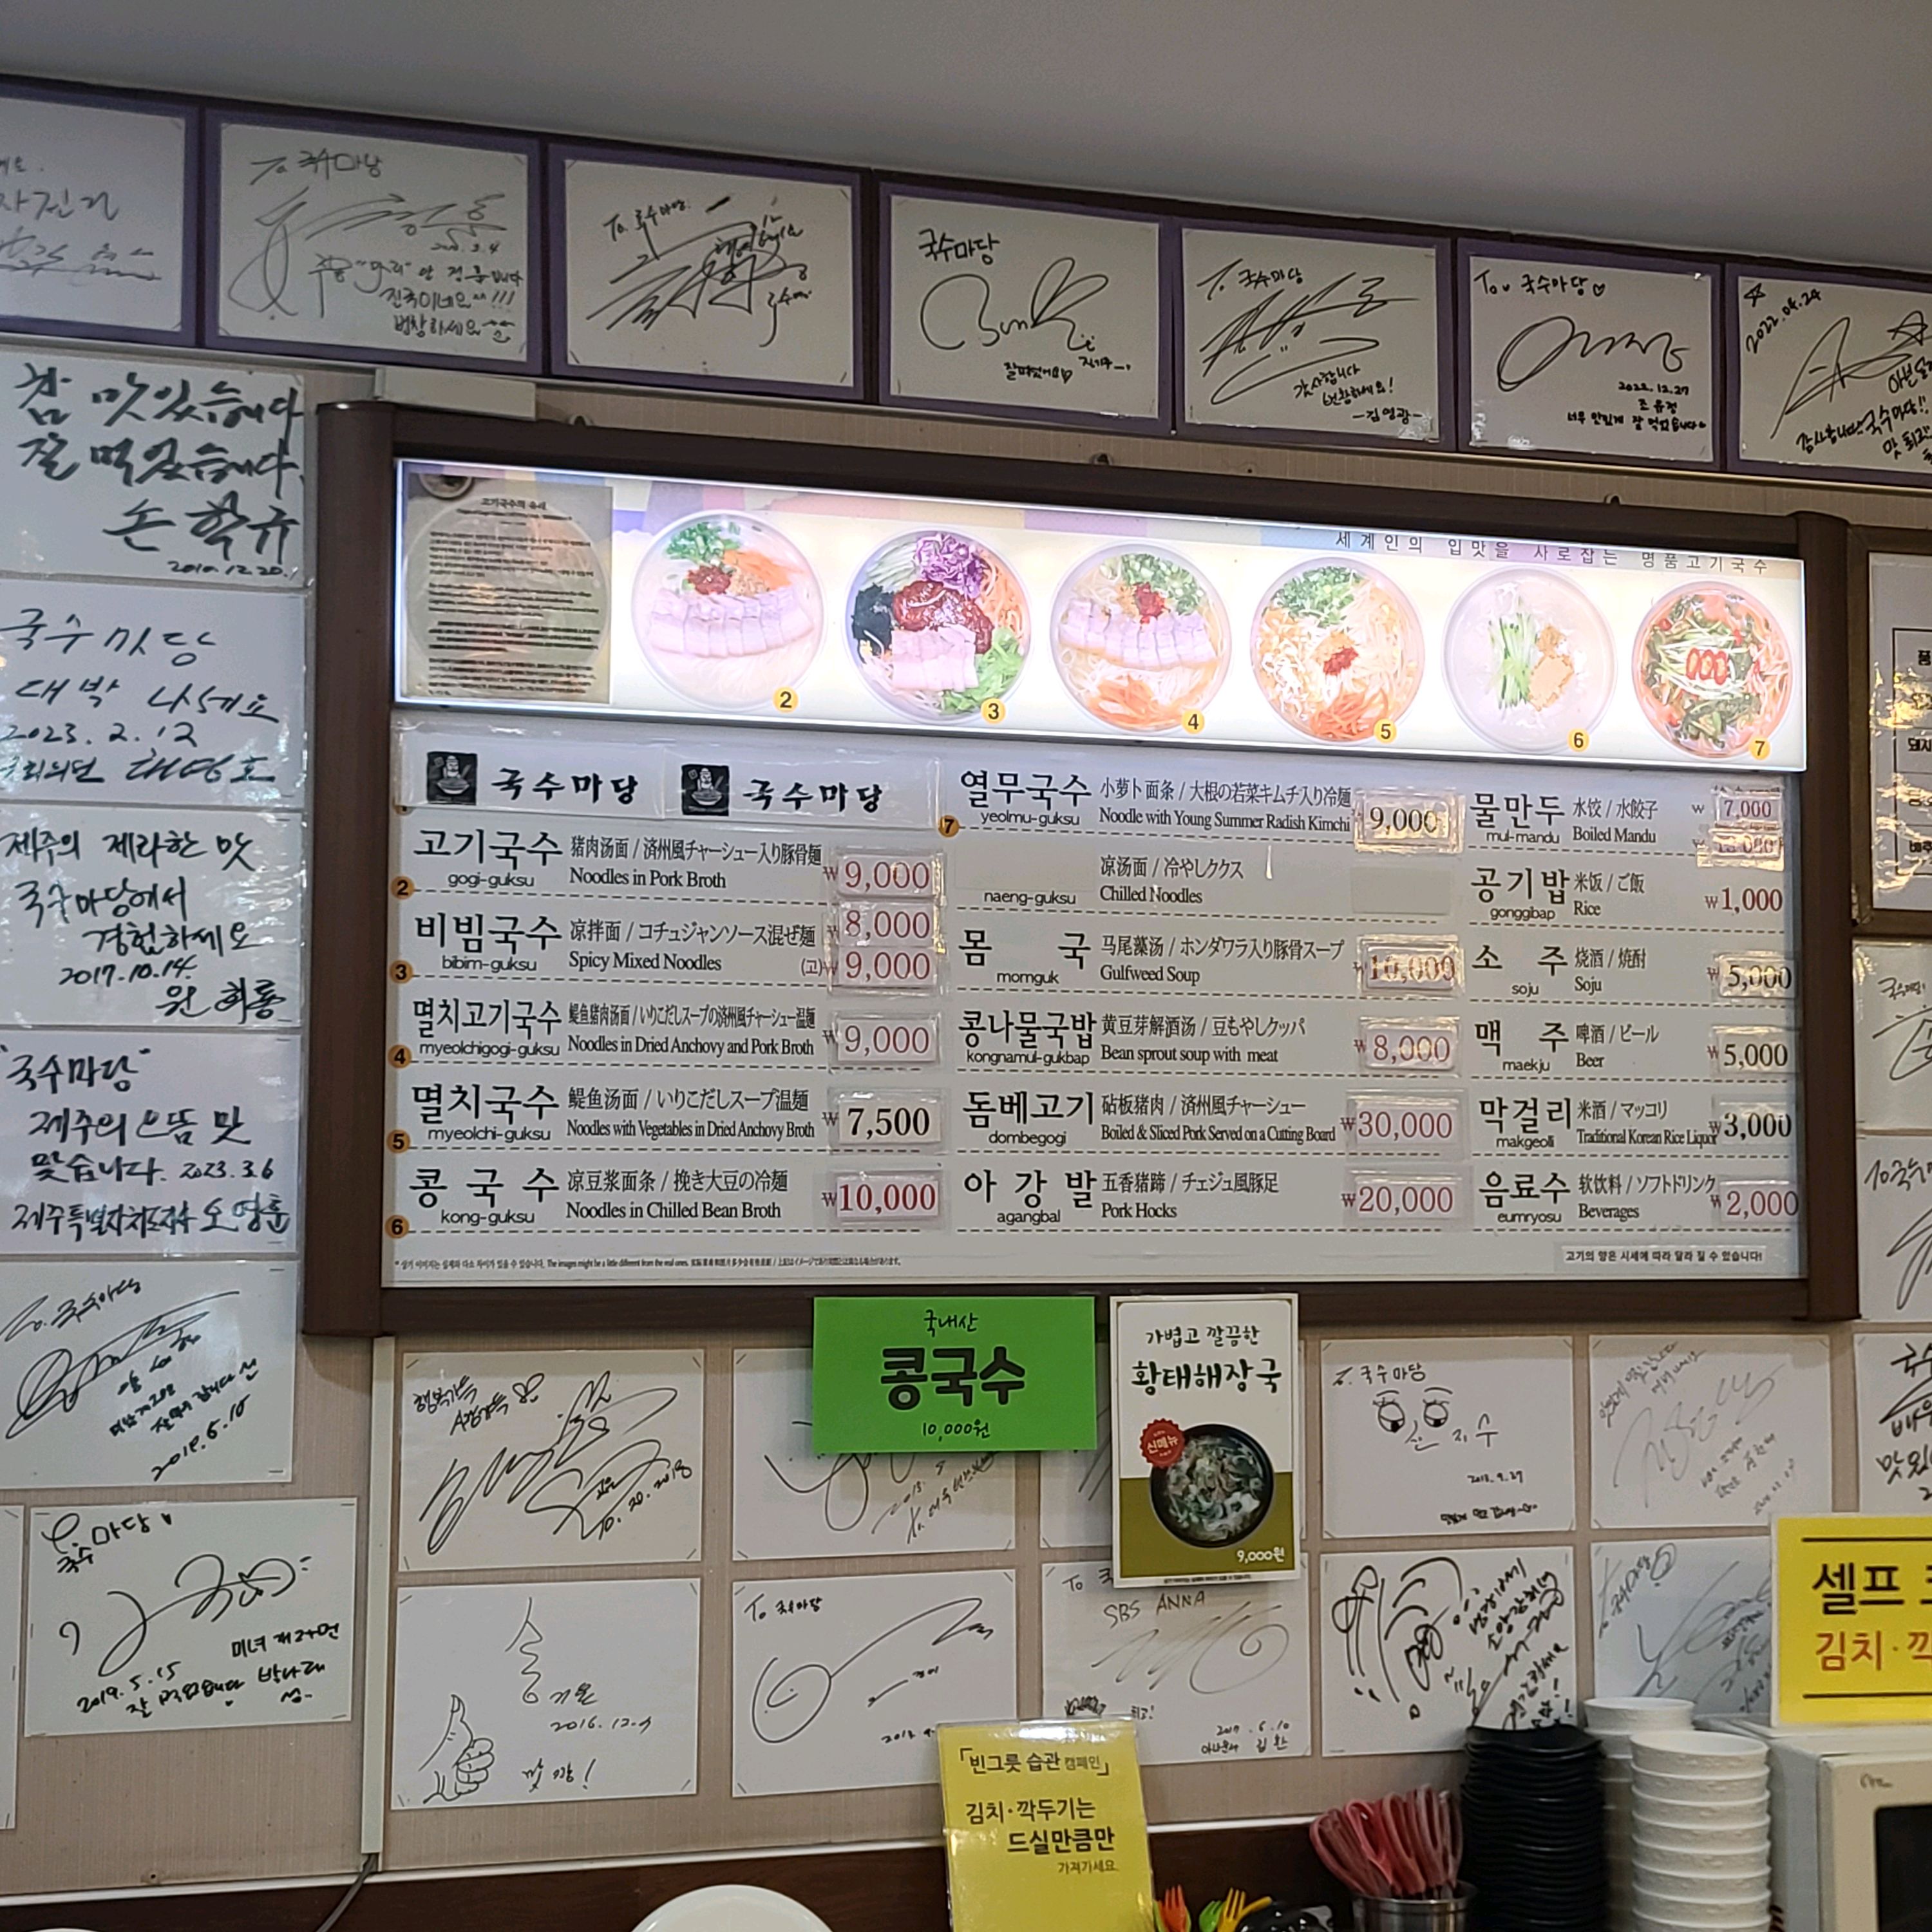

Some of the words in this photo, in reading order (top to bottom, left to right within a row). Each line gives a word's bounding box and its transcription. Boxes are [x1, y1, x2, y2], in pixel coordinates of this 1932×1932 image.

[1336, 531, 1423, 554] 세계인의
[1448, 538, 1510, 559] 입맛을
[1534, 545, 1618, 567] 사로잡는
[1641, 552, 1768, 574] 명품고기국수
[491, 767, 638, 805] 국수마당
[743, 779, 883, 813] 국수마당
[960, 770, 1092, 811] 열무국수
[980, 809, 1080, 828] yeolmu-guksu
[1098, 806, 1144, 824] Noodle
[1145, 809, 1172, 826] with
[1173, 810, 1212, 831] Young
[1214, 811, 1265, 829] Summer
[1265, 813, 1306, 831] Radish
[1307, 815, 1350, 832] Kimchi
[1469, 793, 1566, 829] 물만두
[1572, 797, 1602, 819] 水饺
[1486, 828, 1560, 844] mul-mandu
[1572, 826, 1612, 842] Boiled
[1614, 827, 1656, 844] Mandu
[413, 828, 564, 869] 고기국수
[570, 835, 629, 859] 猪肉汤面
[448, 871, 535, 889] gogi-guksu
[569, 866, 630, 885] Noodles
[632, 868, 647, 886] in
[649, 869, 684, 887] Pork
[686, 870, 726, 889] Broth
[1470, 867, 1571, 905] 공기밥
[1573, 871, 1604, 893] 米饭
[1617, 872, 1645, 894] ご飯
[983, 890, 1076, 907] naeng-guksu
[1099, 885, 1147, 902] Chilled
[1149, 886, 1203, 904] Noodles
[1490, 905, 1556, 922] gonggibap
[1573, 900, 1601, 916] Rice
[415, 912, 563, 955] 비빔국수
[442, 954, 537, 974] bibim-guksu
[569, 950, 611, 972] Spicy
[612, 951, 660, 969] Mixed
[663, 952, 722, 971] Noodles
[996, 970, 1059, 987] momguk
[1100, 964, 1164, 981] Gulfweed
[1166, 965, 1200, 987] Soup
[1574, 976, 1602, 996] Soju
[1511, 982, 1539, 998] soju
[413, 997, 562, 1041] 멸치고기국수
[958, 1009, 1097, 1050] 콩나물국밥
[1576, 1022, 1605, 1045] 啤酒
[1620, 1023, 1660, 1044] ビール
[419, 1039, 560, 1059] myeolchigogi-guksu
[567, 1034, 618, 1052] Noodles
[620, 1035, 632, 1053] in
[634, 1036, 669, 1053] Dried
[670, 1036, 725, 1059] Anchovy
[726, 1037, 749, 1054] and
[751, 1037, 779, 1055] Pork
[781, 1038, 815, 1056] Broth
[967, 1048, 1090, 1067] kongnamul-gukbap
[1100, 1043, 1135, 1061] Bean
[1137, 1047, 1178, 1065] sprout
[1179, 1049, 1211, 1066] soup
[1213, 1045, 1242, 1062] with
[1247, 1049, 1279, 1063] meat
[1502, 1058, 1551, 1074] maekju
[1575, 1052, 1605, 1068] Beer
[412, 1083, 560, 1126] 멸치국수
[962, 1090, 1094, 1128] 돔베고기
[1479, 1096, 1571, 1134] 막걸리
[1577, 1099, 1607, 1121] 米酒
[1620, 1100, 1667, 1121] マッコリ
[428, 1125, 551, 1144] myeolchi-guksu
[567, 1119, 611, 1137] Noodles
[612, 1119, 636, 1137] with
[638, 1119, 693, 1141] Vegetables
[694, 1119, 705, 1137] in
[706, 1120, 737, 1137] Dried
[737, 1121, 784, 1142] Anchovy
[786, 1121, 815, 1138] Broth
[988, 1130, 1067, 1148] dombegogi
[1576, 1128, 1627, 1144] Traditional
[1627, 1128, 1662, 1145] Korean
[1663, 1129, 1685, 1145] Rice
[1496, 1134, 1555, 1151] makgeolli
[1478, 1171, 1571, 1208] 음료수
[440, 1209, 535, 1227] kong-guksu
[565, 1201, 627, 1219] Noodles
[629, 1201, 644, 1218] in
[647, 1201, 699, 1219] Chilled
[701, 1201, 739, 1218] Bean
[741, 1201, 782, 1218] Broth
[996, 1209, 1061, 1226] agangbal
[1101, 1202, 1133, 1218] Pork
[1135, 1202, 1177, 1218] Hocks
[1497, 1213, 1562, 1226] eumryosu
[1578, 1202, 1640, 1223] Beverages
[923, 1309, 979, 1338] 국내산
[1145, 1325, 1200, 1348] 가볍고
[1206, 1325, 1260, 1346] 깔끔한
[880, 1345, 1026, 1410] 콩국수
[1131, 1358, 1282, 1396] 황태해장국
[922, 1419, 990, 1442] 10,000원
[1236, 1546, 1285, 1564] 9,000원
[1812, 1562, 1905, 1615] 셀프
[1103, 1600, 1141, 1629] SBS
[1027, 1752, 1061, 1772] 습관
[1007, 1826, 1115, 1855] 드실만큼만
